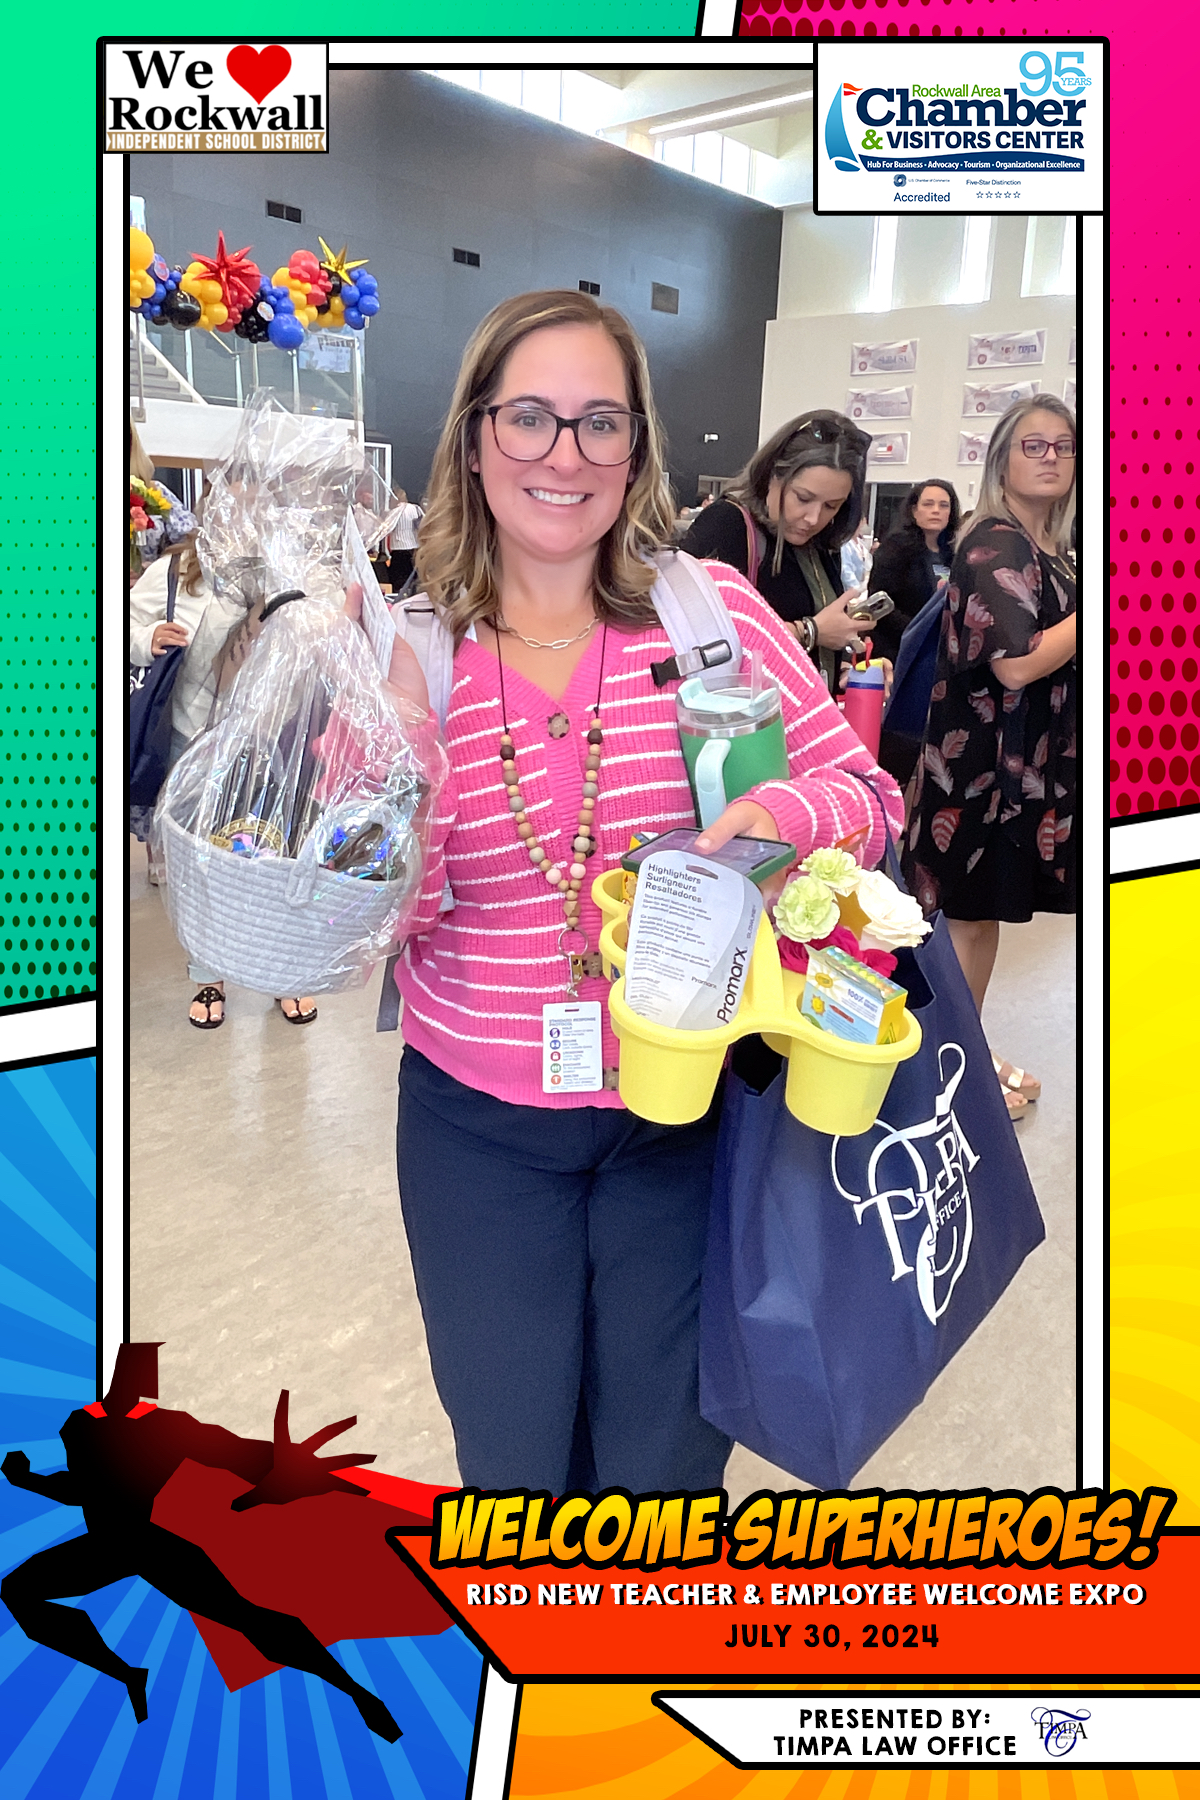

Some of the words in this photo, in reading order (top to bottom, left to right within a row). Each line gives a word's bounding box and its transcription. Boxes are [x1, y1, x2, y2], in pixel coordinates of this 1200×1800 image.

[646, 872, 697, 892] Surligneurs
[648, 863, 701, 884] Highlighters
[645, 881, 702, 903] Resaltadores
[717, 946, 747, 1024] Promarx
